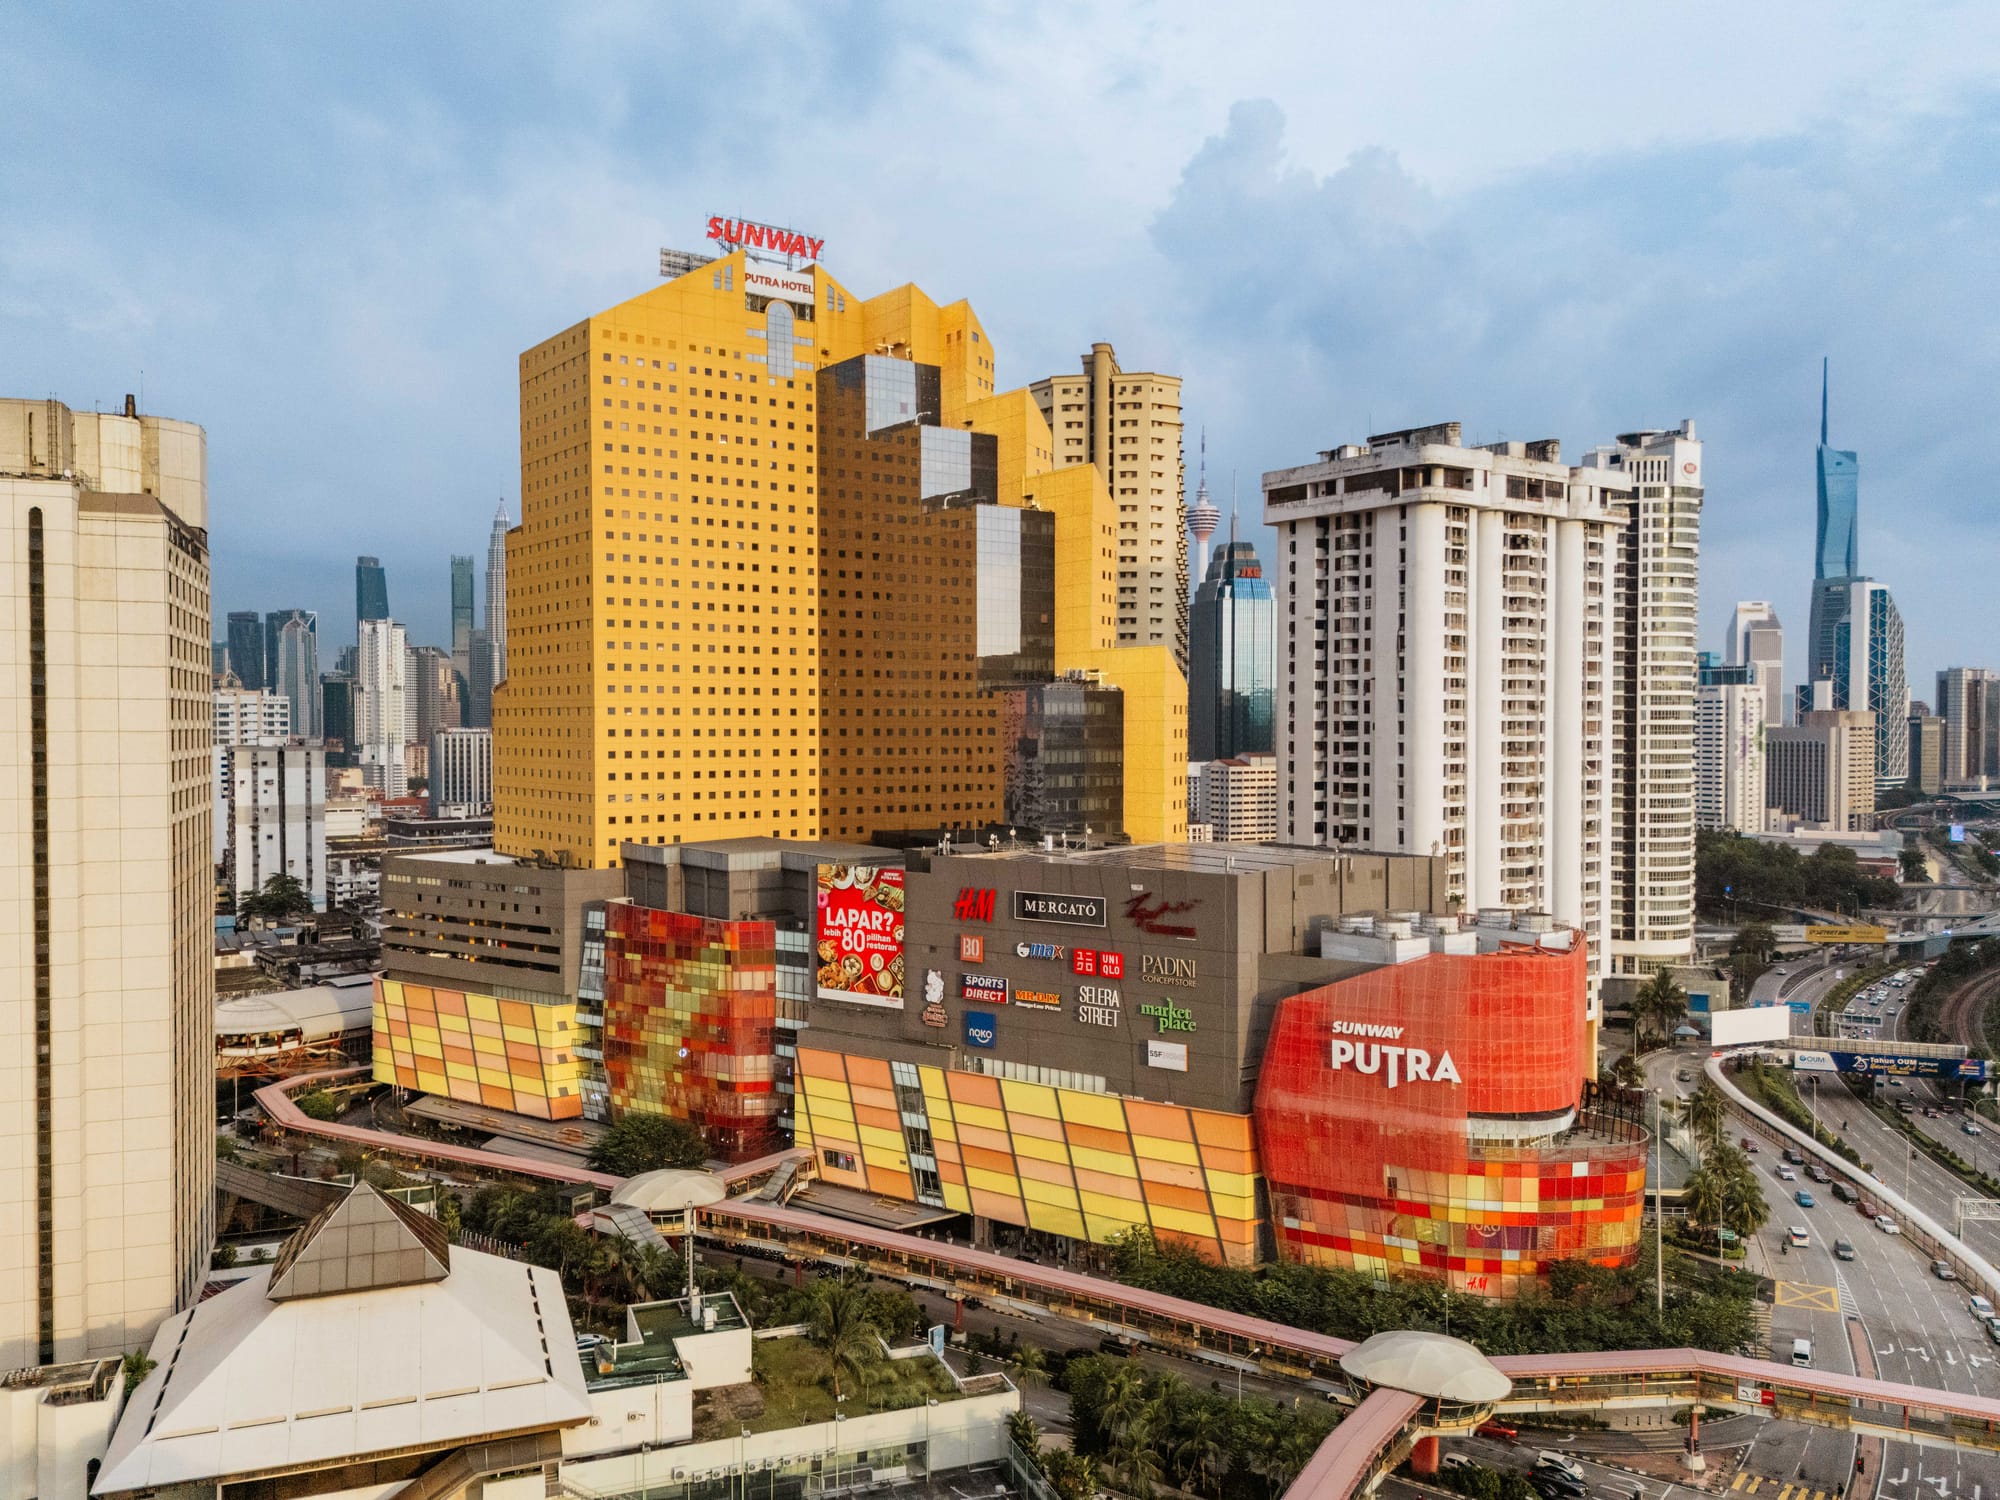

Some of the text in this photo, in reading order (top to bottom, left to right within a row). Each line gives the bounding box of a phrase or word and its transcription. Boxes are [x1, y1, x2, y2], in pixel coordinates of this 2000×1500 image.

[706, 216, 824, 260] SUNWAY
[745, 273, 814, 294] PUTRA HOTEL
[954, 887, 997, 924] H&M
[1024, 899, 1097, 917] MERCATÓ
[826, 907, 894, 932] LAPAR?
[823, 927, 891, 953] lebih 80 pilihan
[866, 942, 897, 951] restoran
[1102, 954, 1119, 964] UNI
[1142, 954, 1197, 978] PADINI
[1102, 966, 1120, 975] QLO
[965, 975, 1004, 989] SPORTS
[1142, 975, 1198, 988] CONCEPT STORE
[965, 988, 1004, 1001] DIRECT
[1079, 985, 1120, 1008] SELERA
[1079, 1005, 1121, 1027] STREET
[1141, 997, 1192, 1019] market
[1158, 1015, 1197, 1034] place
[1332, 1020, 1404, 1039] SUNWAY
[1331, 1039, 1462, 1089] PUTRA
